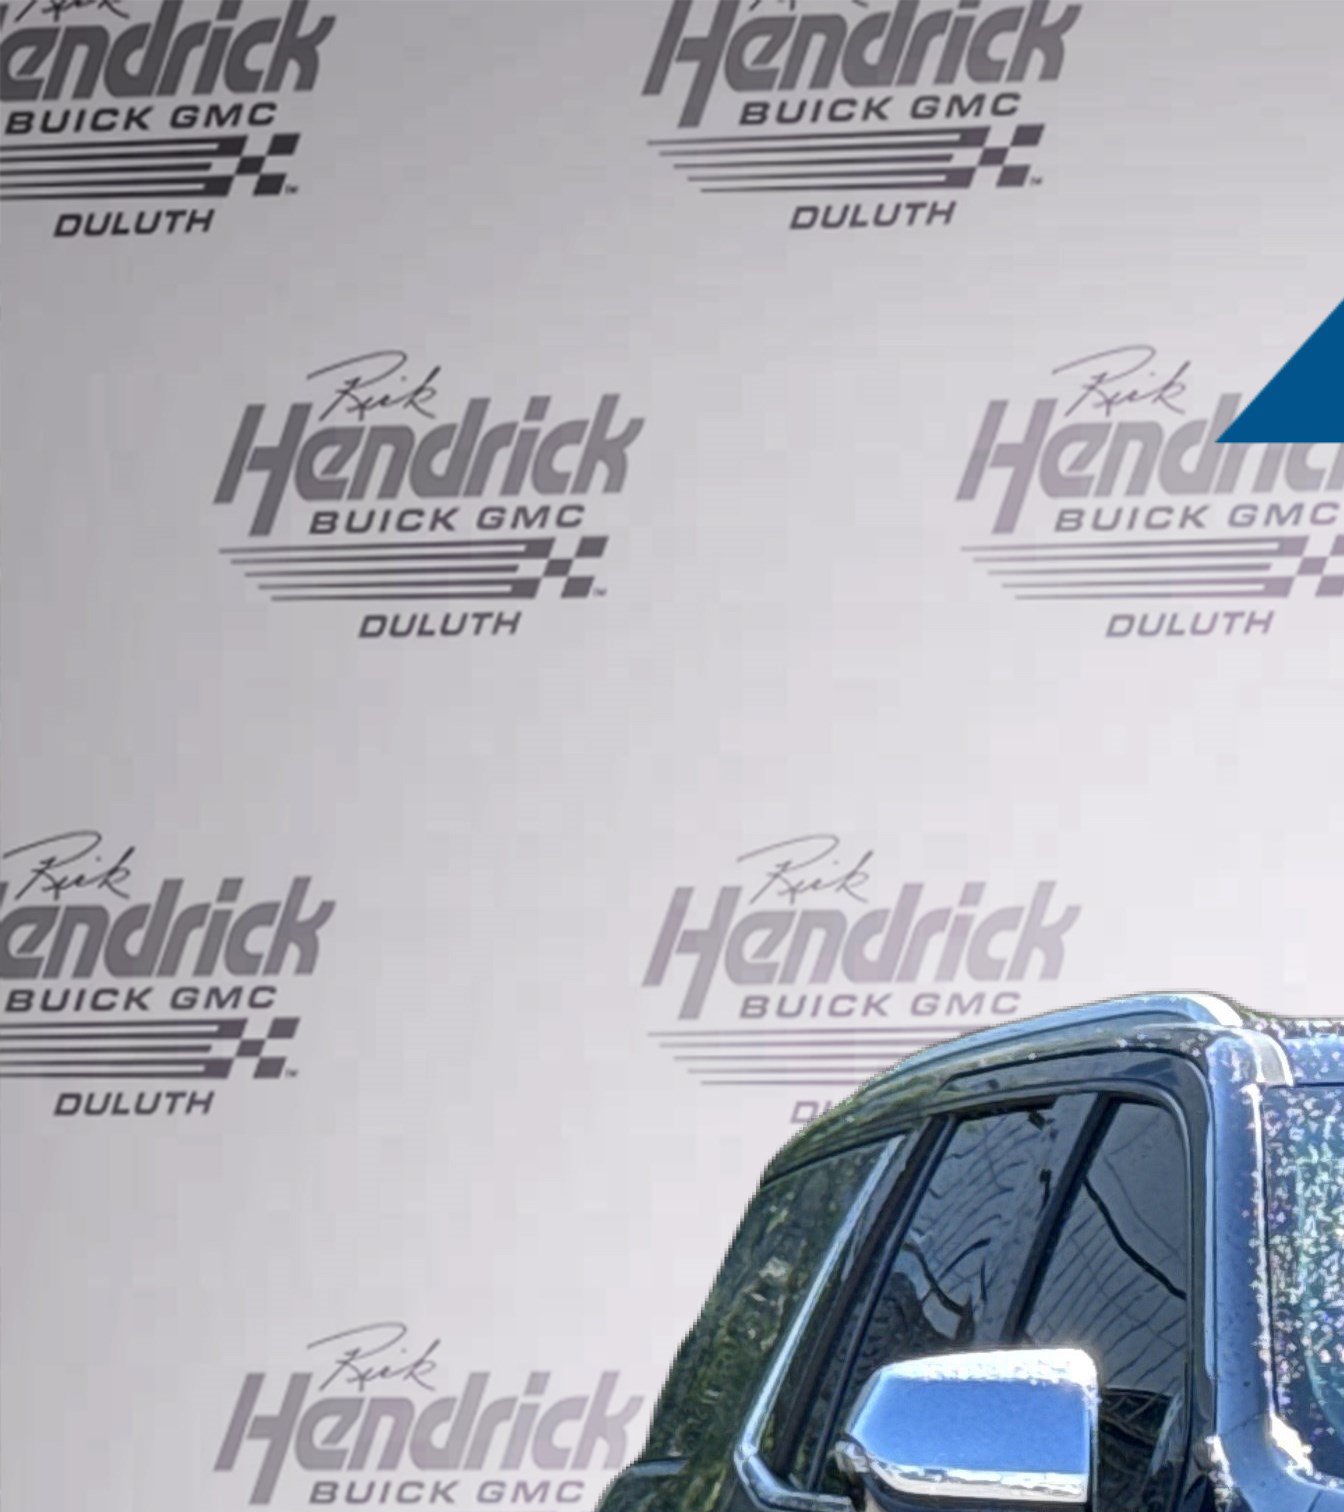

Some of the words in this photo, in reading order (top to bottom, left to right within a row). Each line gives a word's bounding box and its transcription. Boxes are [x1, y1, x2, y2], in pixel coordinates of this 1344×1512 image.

[5, 106, 154, 135] BUICK
[170, 102, 277, 129] GMC
[739, 97, 893, 125] BUICK
[910, 93, 1022, 120] GMC
[54, 209, 215, 237] DULUTH
[789, 201, 957, 230] DULUTH
[212, 393, 645, 537] Hendrick
[309, 508, 460, 535] BUICK
[476, 504, 586, 530] GMC
[1054, 505, 1210, 533] BUICK
[1227, 501, 1341, 528] GMC
[358, 611, 522, 639] DULUTH
[1105, 610, 1275, 638] DULUTH
[641, 880, 1082, 1021] Hendrick
[4, 986, 154, 1013] BUICK
[170, 985, 277, 1010] GMC
[739, 992, 892, 1020] BUICK
[909, 991, 1022, 1016] GMC
[54, 1091, 215, 1116] DULUTH
[213, 1370, 645, 1506] Hendrick
[309, 1480, 460, 1505] BUICK
[477, 1480, 586, 1504] GMC
